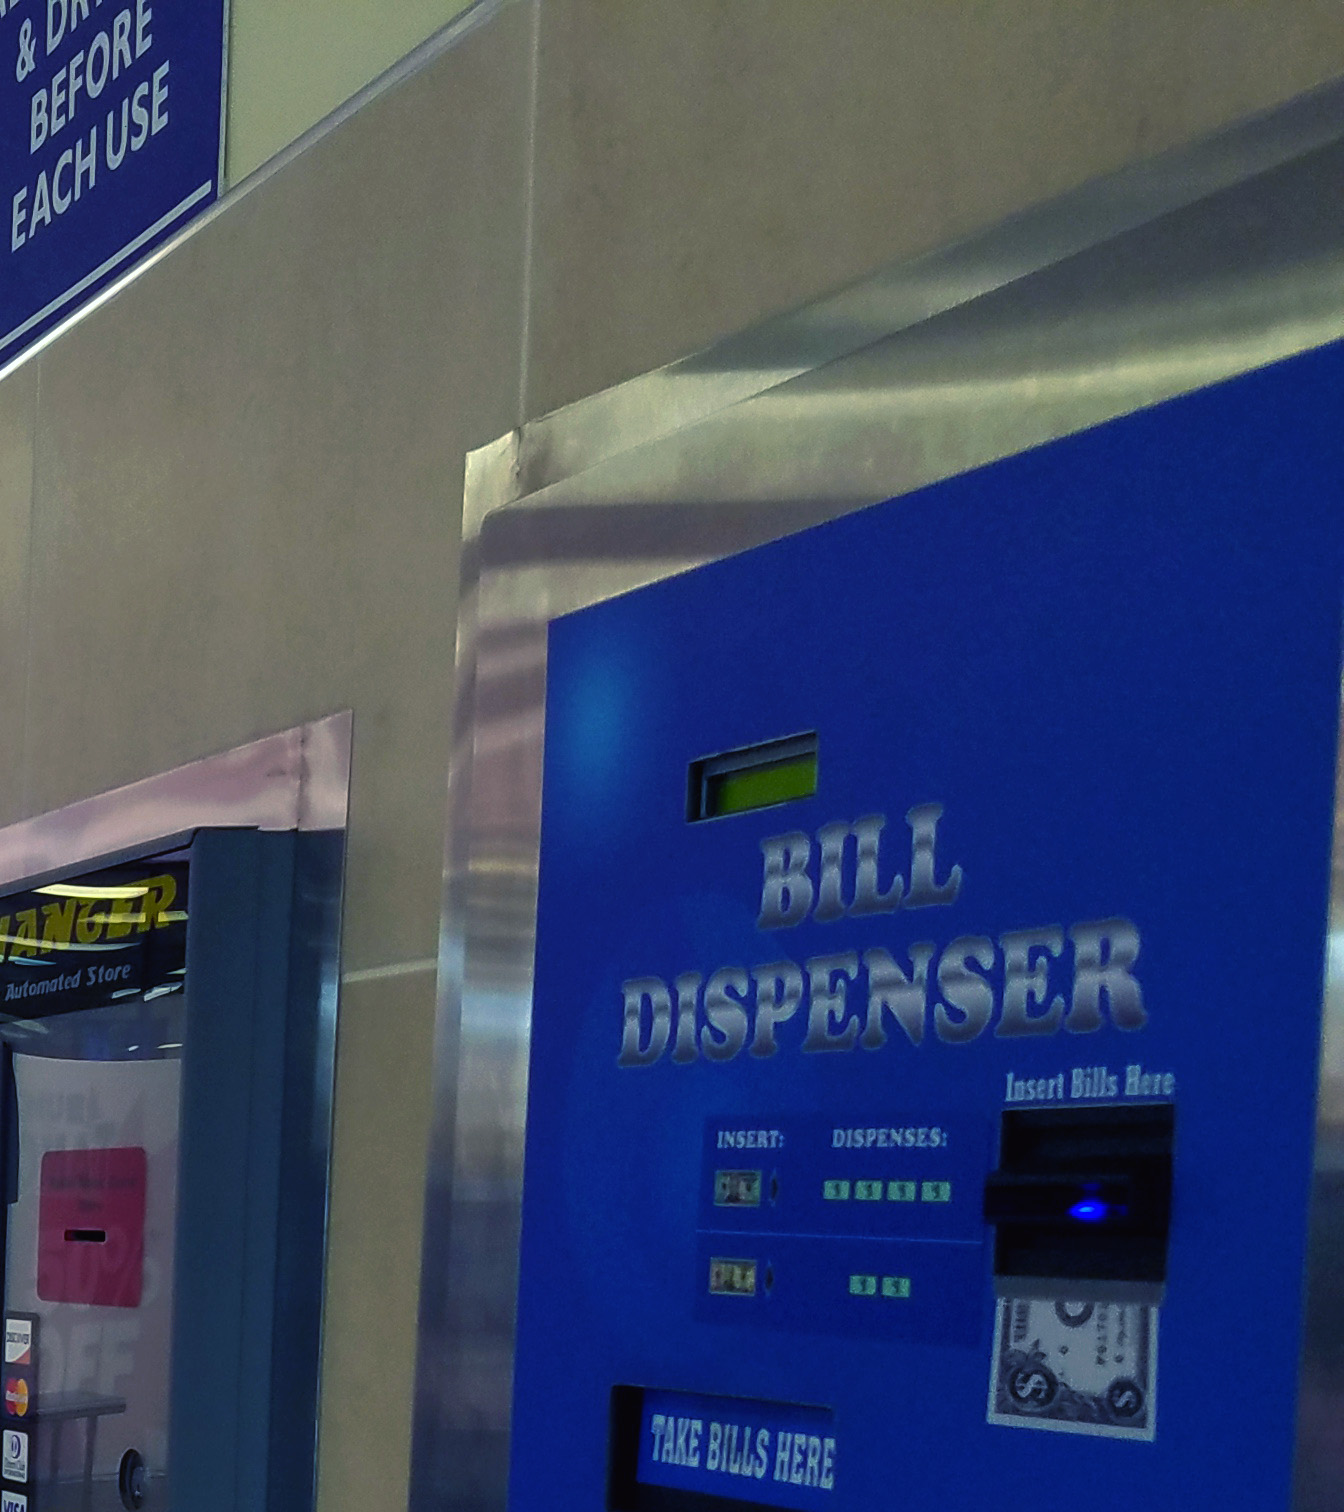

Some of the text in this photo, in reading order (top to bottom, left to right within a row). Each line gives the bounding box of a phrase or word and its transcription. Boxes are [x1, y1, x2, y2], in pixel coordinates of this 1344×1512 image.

[15, 18, 37, 82] &
[30, 0, 153, 155] BEFORE
[11, 60, 170, 253] EACH USE
[756, 803, 963, 930] BILL
[5, 972, 82, 1001] Automated
[87, 962, 132, 987] Store
[616, 917, 1149, 1068] DISPENSER
[1004, 1063, 1176, 1103] Insert Bills Here
[651, 1413, 837, 1491] TAKE BILLS HERE
